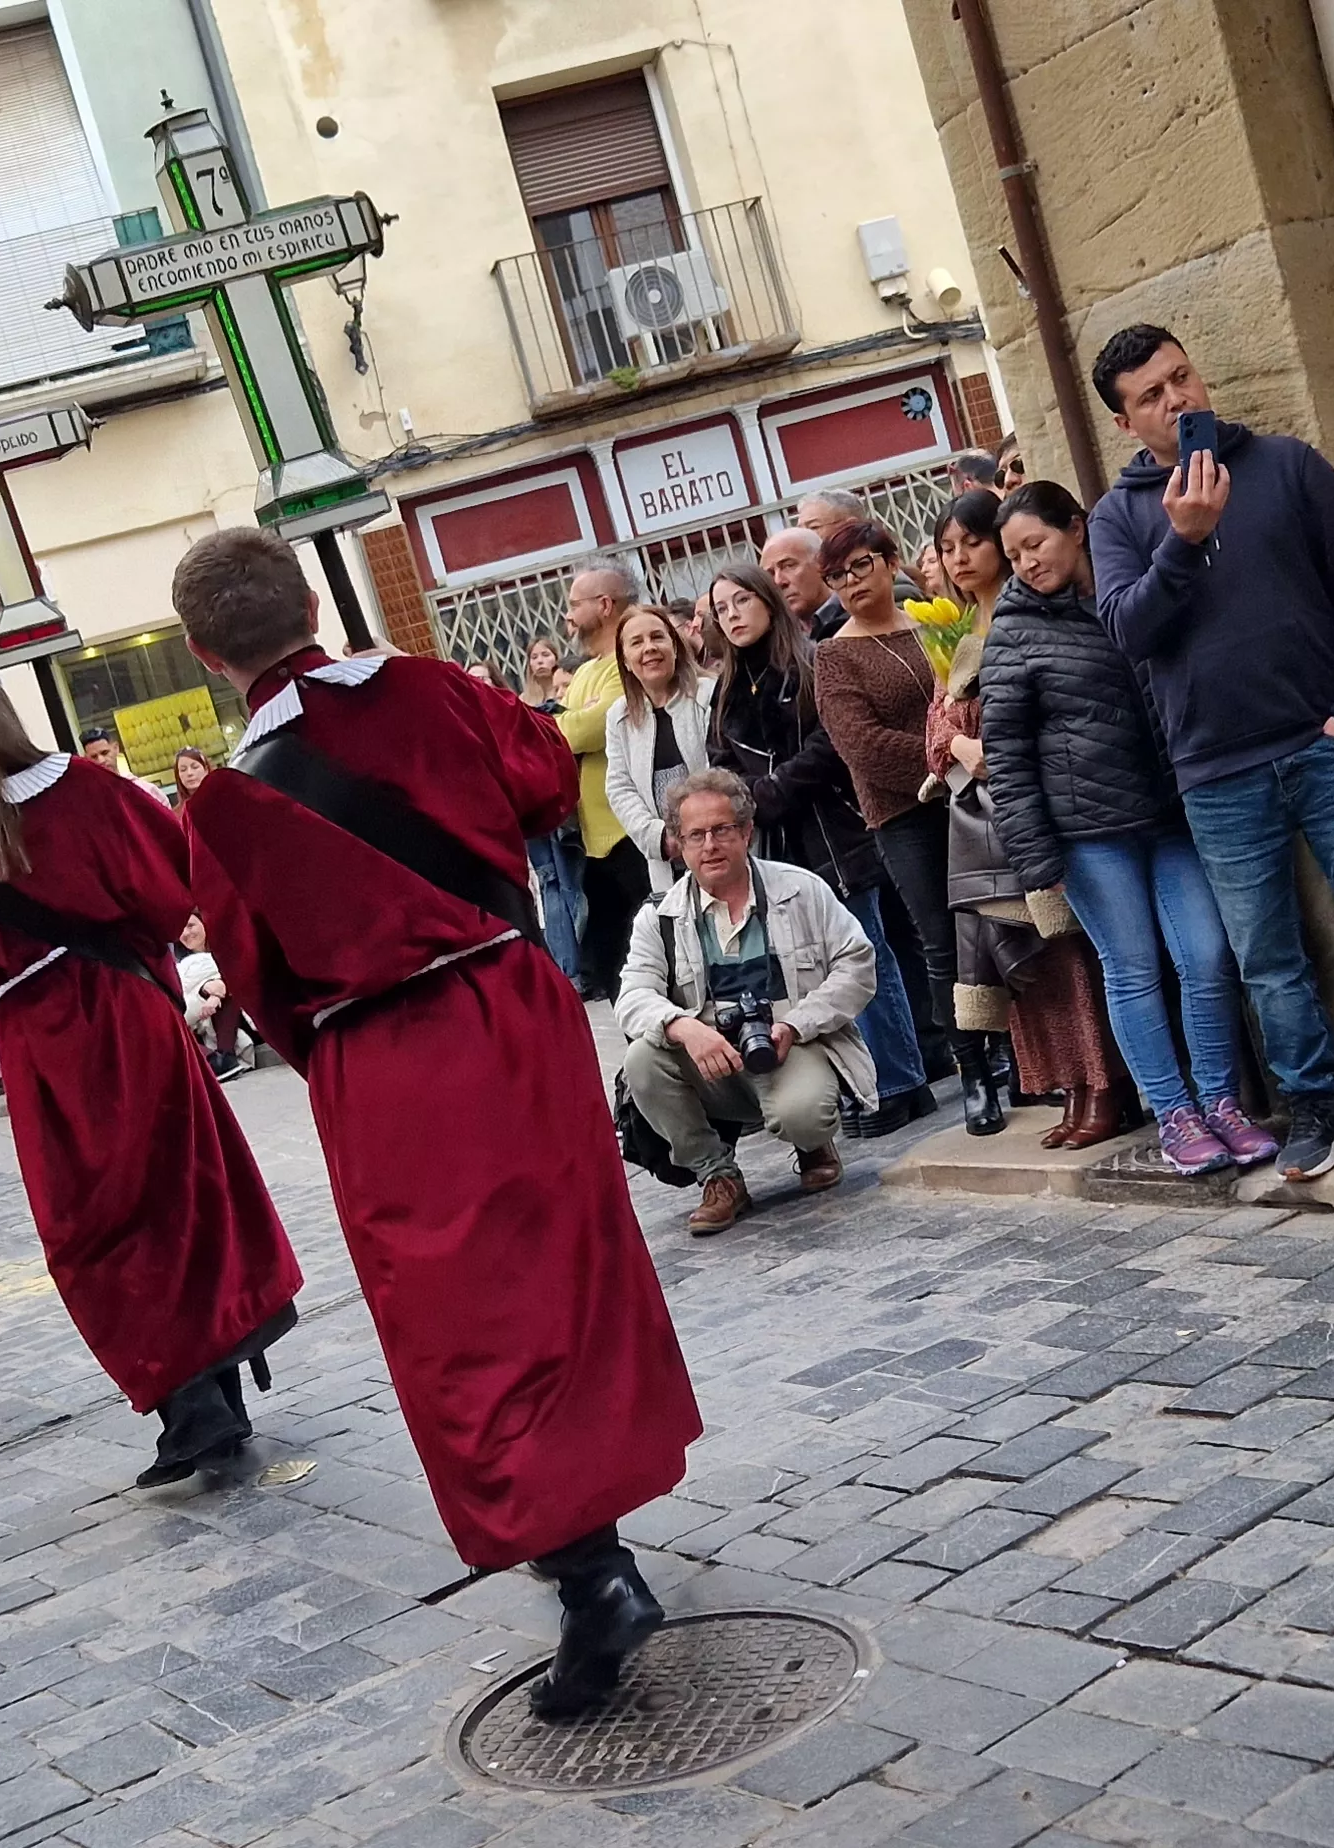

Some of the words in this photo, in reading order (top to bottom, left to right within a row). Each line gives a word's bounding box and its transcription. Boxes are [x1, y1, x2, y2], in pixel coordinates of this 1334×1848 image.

[125, 252, 178, 276] PADRE
[183, 240, 213, 260] MIO
[219, 233, 241, 250] EN
[243, 225, 275, 244] TUS
[278, 211, 335, 236] MANOS
[138, 256, 238, 293] ENCOMIENDO
[242, 251, 263, 267] MI
[268, 232, 336, 260] ESPIRITU
[661, 450, 695, 480] EL
[639, 470, 734, 519] BARATO
